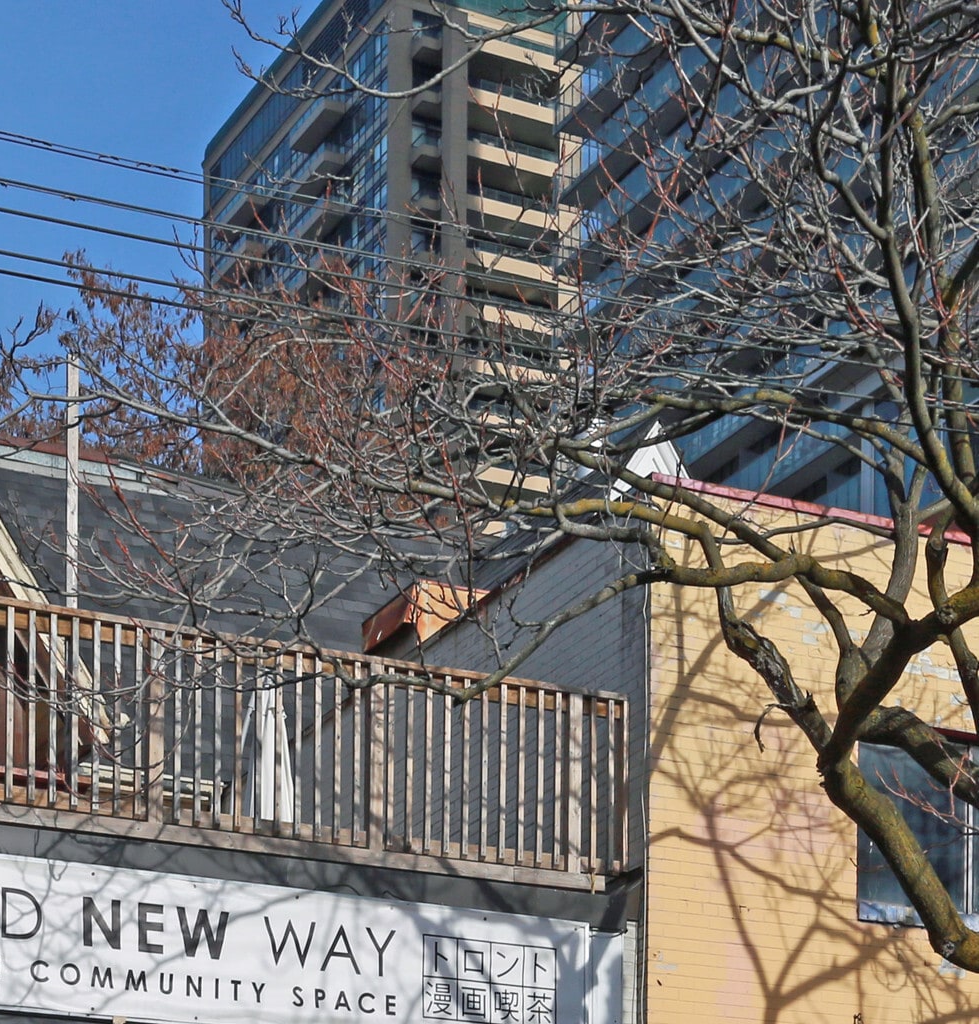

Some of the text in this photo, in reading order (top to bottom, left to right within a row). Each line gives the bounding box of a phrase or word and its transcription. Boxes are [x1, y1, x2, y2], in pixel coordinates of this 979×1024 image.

[81, 896, 229, 961] NEW
[263, 915, 397, 978] WAY
[434, 941, 547, 984] トロント
[29, 958, 266, 1004] COMMUNITY
[292, 985, 398, 1017] SPACE
[425, 980, 553, 1024] 漫画喫茶
